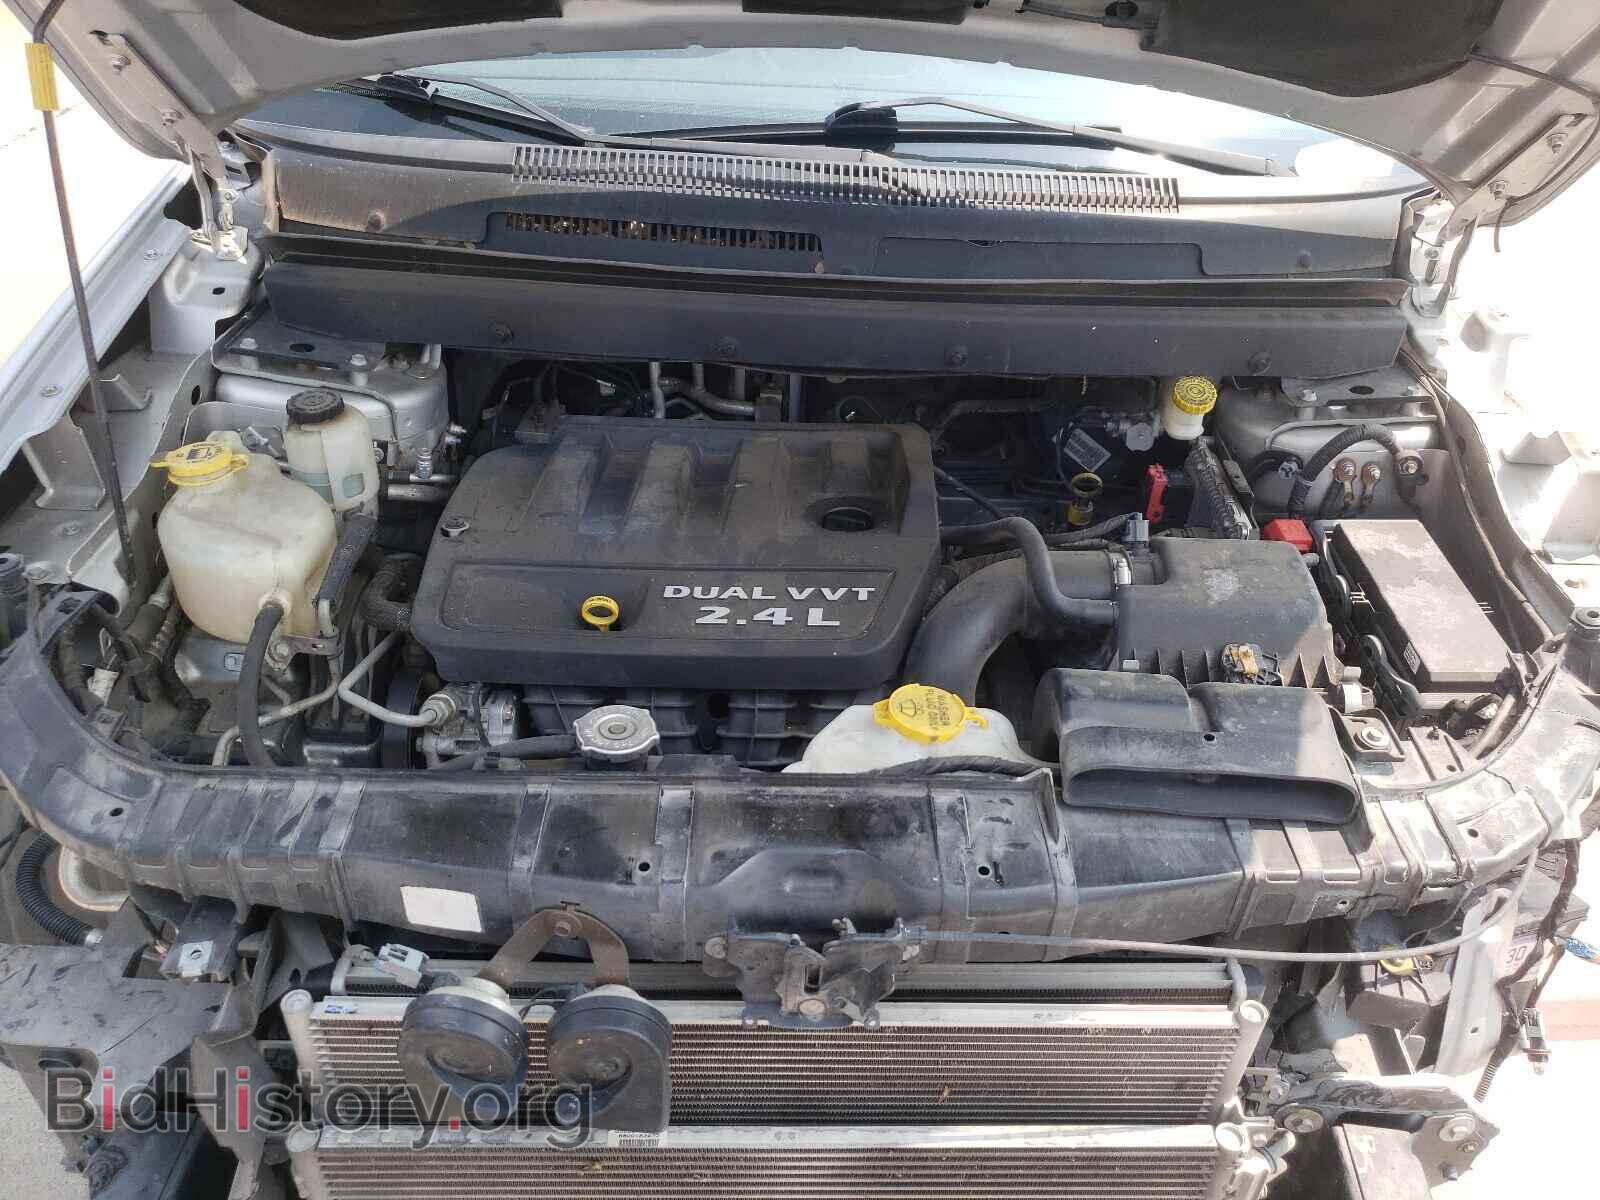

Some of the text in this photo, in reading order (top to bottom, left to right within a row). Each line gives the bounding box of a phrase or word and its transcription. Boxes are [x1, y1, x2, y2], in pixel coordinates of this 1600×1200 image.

[663, 585, 880, 601] DUAL VVT
[937, 694, 952, 727] WASHER
